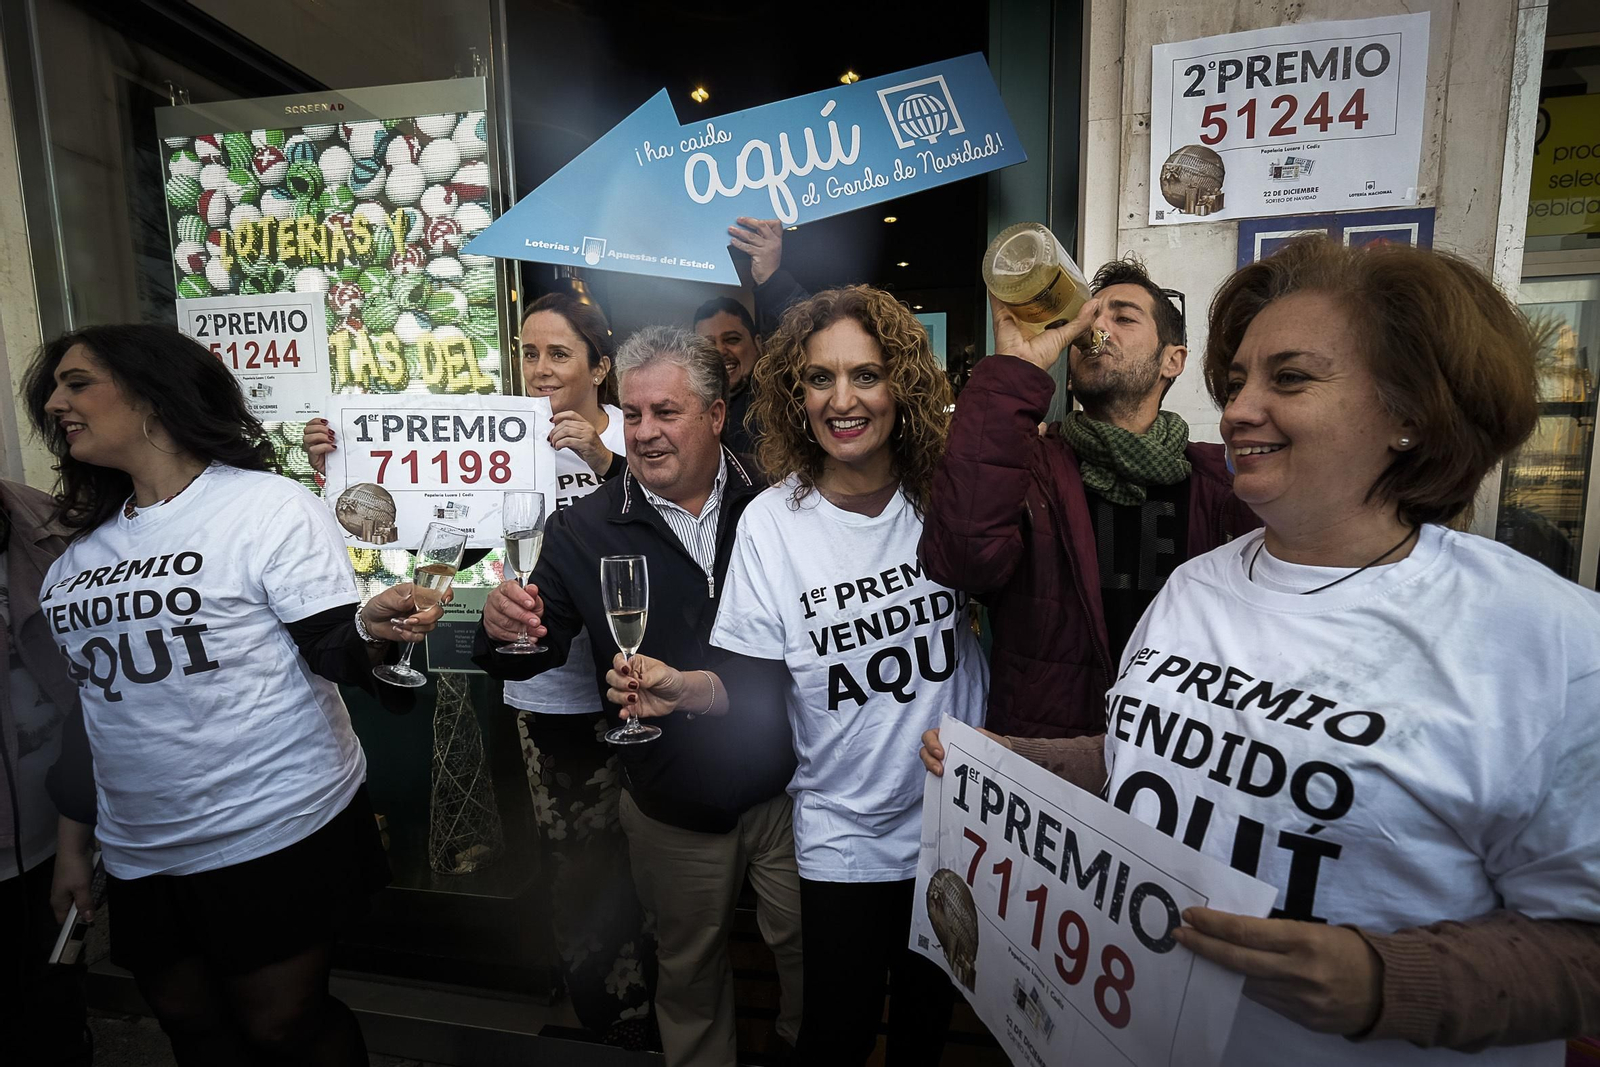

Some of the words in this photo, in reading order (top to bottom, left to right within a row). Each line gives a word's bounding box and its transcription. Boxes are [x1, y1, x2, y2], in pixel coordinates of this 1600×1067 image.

[1199, 88, 1369, 146] 51244
[684, 99, 861, 225] aquí
[802, 183, 821, 208] el
[826, 166, 890, 199] Gordo
[893, 158, 917, 183] de
[917, 132, 1006, 175] Navidad!
[1283, 186, 1320, 196] DICIEMBRE
[525, 238, 570, 251] Loterías
[572, 245, 580, 255] y
[607, 249, 657, 264] Apuestas
[660, 255, 677, 265] del
[679, 258, 715, 270] Estado
[370, 449, 512, 485] 71198
[557, 473, 601, 490] PR
[67, 551, 204, 593] PREMIO
[827, 626, 959, 711] AQU
[1147, 654, 1386, 747] PREMIO
[963, 826, 1135, 1030] 71198
